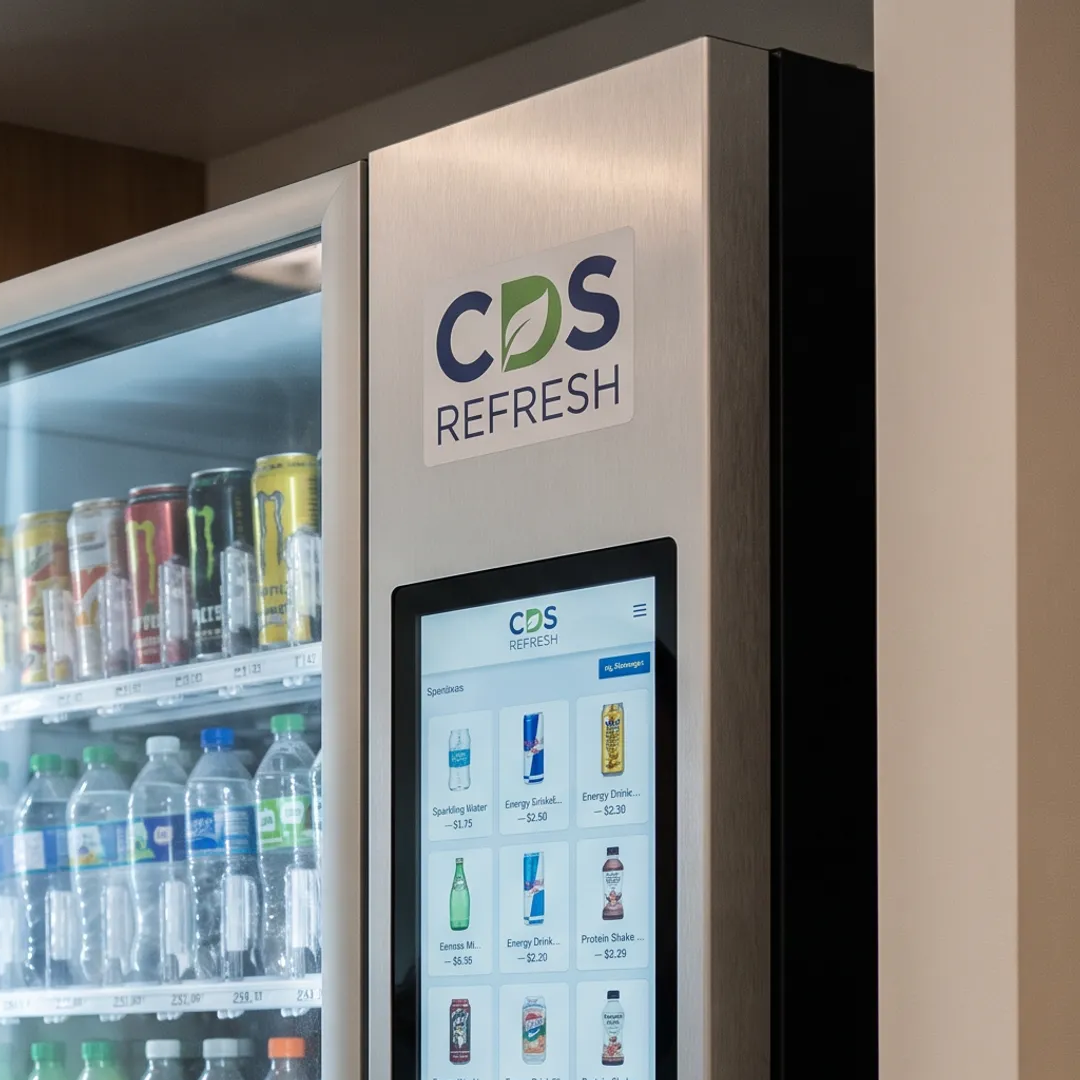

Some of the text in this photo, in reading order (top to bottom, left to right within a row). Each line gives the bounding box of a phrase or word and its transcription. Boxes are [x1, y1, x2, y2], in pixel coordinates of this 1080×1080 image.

[436, 255, 620, 383] CDS
[437, 364, 619, 446] REFRESH
[509, 605, 558, 635] CDS
[509, 633, 558, 651] REFRESH
[582, 792, 609, 802] Energy
[466, 803, 488, 813] Water
[505, 800, 531, 810] Energy
[507, 938, 532, 949] Energy
[581, 933, 609, 944] Protein
